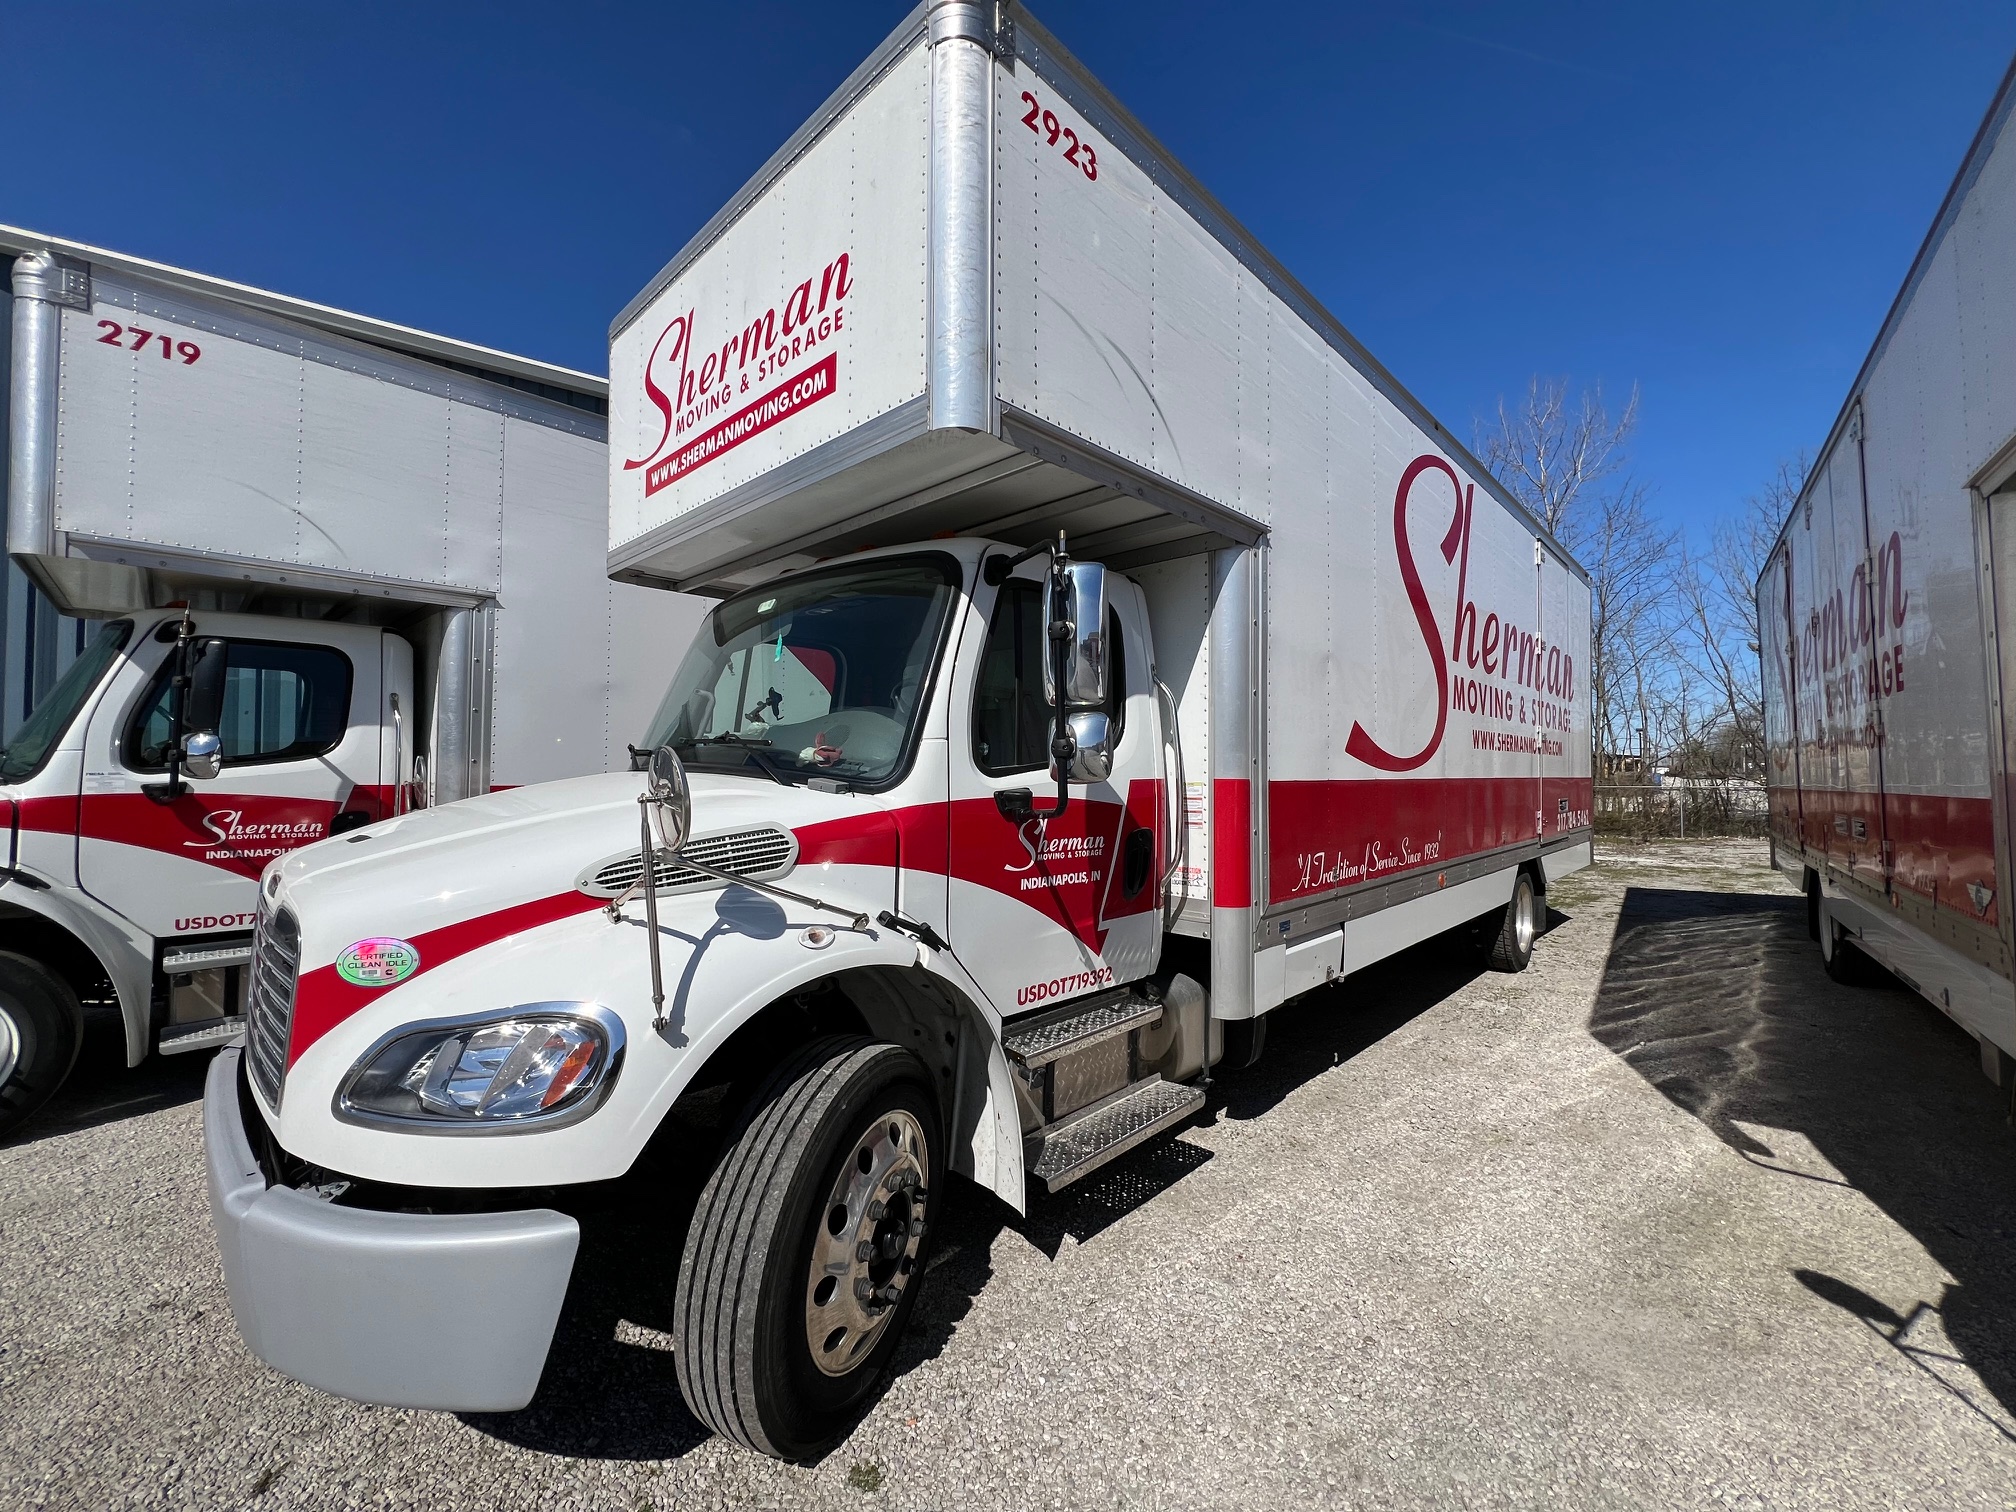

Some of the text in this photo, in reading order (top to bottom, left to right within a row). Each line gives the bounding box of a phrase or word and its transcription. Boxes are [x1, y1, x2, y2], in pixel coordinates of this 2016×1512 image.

[1021, 91, 1098, 181] 2923
[96, 320, 201, 365] 2719
[623, 252, 853, 470] Sherman
[676, 306, 843, 436] MOVING & STORAGE
[651, 368, 827, 487] WWW.SHERMANMOVING.COM
[1345, 454, 1574, 773] Sherman
[1453, 675, 1513, 722] MOVING
[1519, 695, 1527, 724] &
[1837, 644, 1905, 715] STORAGE
[1472, 729, 1563, 756] WWW.SHERMANMOING.COM
[183, 810, 323, 847] Sherman
[1004, 818, 1105, 871] Sherman
[1038, 848, 1102, 861] MOVING & STORAGE
[1312, 851, 1358, 886] Tradition
[1360, 842, 1370, 881] of
[1369, 840, 1398, 872] Service
[1399, 837, 1421, 866] Since
[1020, 870, 1101, 891] INDIANAPOLIS, IN
[347, 959, 408, 969] CLEAN IDLE
[353, 952, 403, 961] CERTIFIED
[1017, 965, 1113, 1006] USDOT719392
